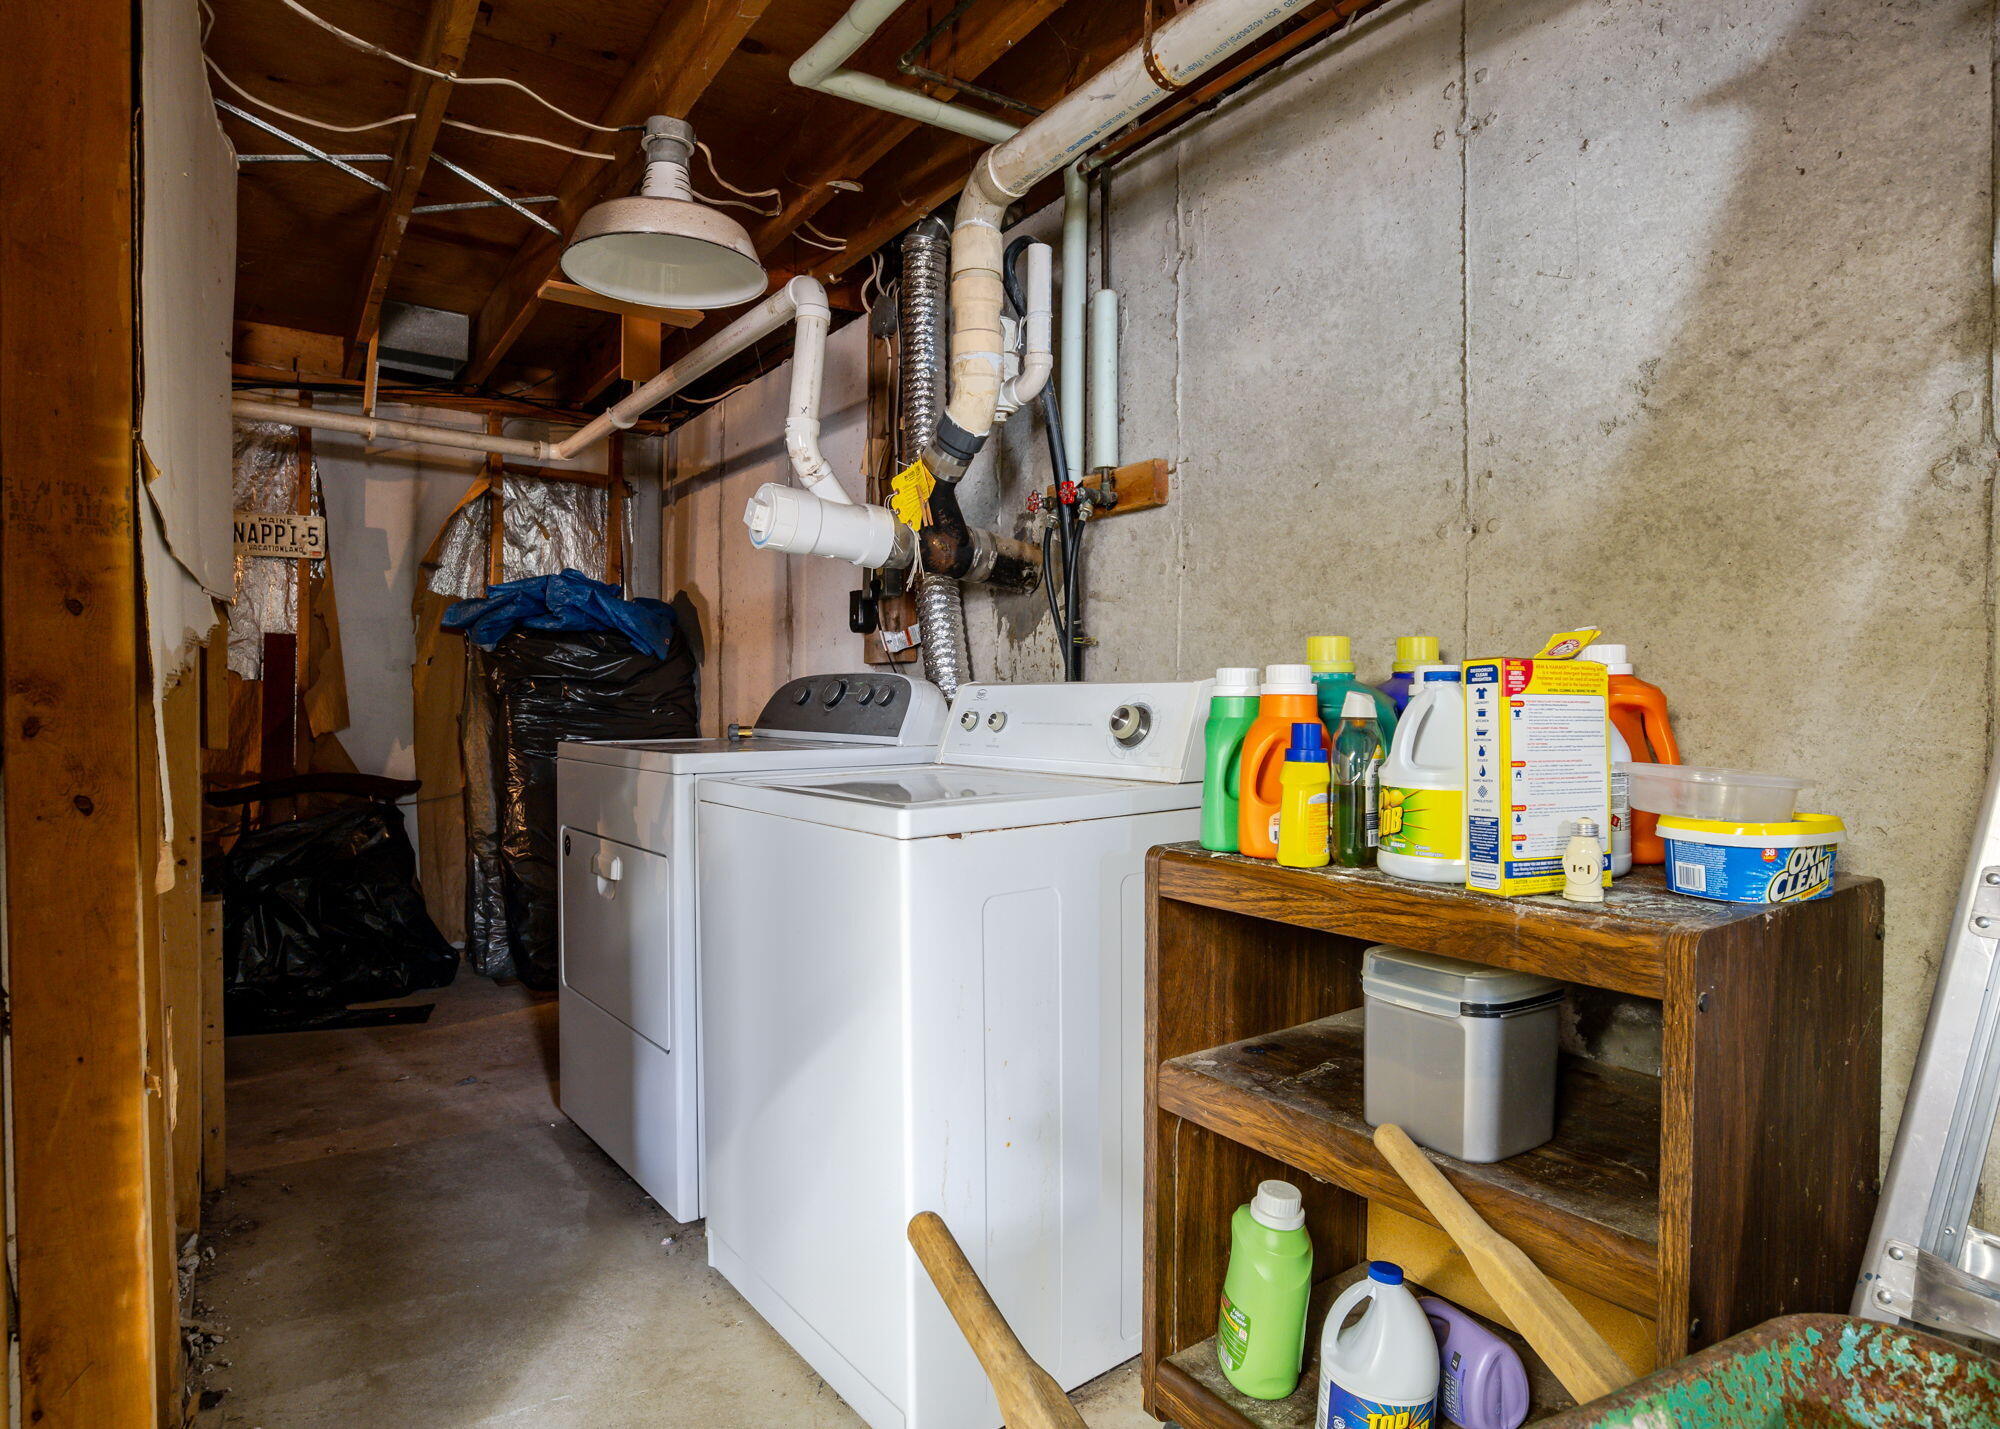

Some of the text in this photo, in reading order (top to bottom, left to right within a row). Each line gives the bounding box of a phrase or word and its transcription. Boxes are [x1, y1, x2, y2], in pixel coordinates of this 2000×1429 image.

[258, 517, 293, 526] MAINE
[249, 545, 304, 553] VACATIONLAND
[1788, 846, 1822, 875] OXI
[1769, 856, 1830, 902] CLEAN
